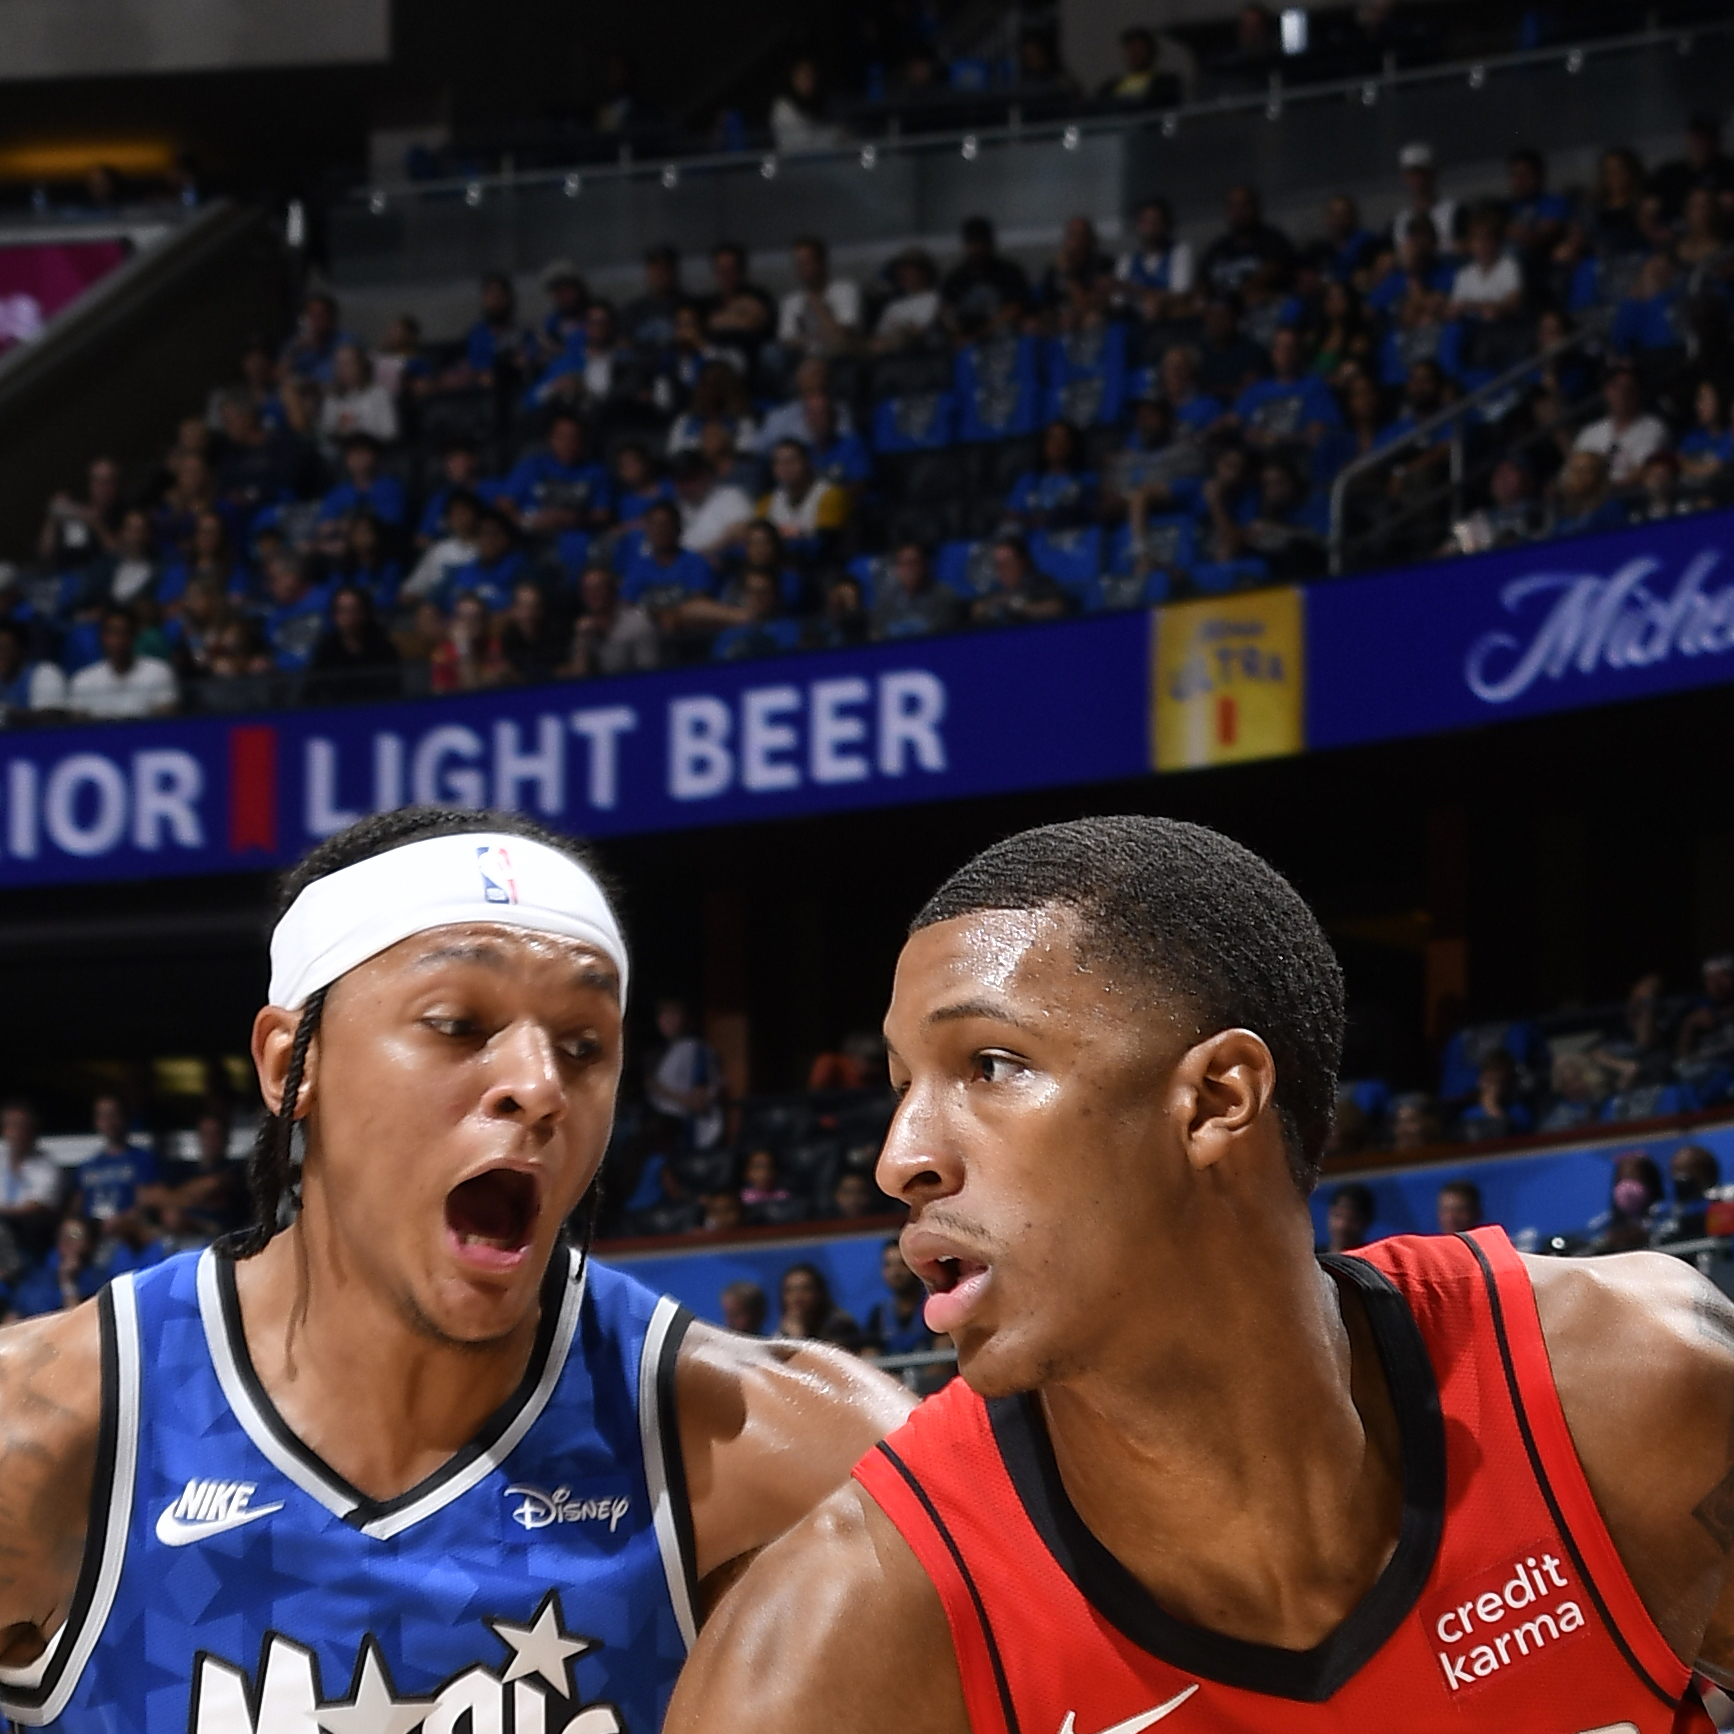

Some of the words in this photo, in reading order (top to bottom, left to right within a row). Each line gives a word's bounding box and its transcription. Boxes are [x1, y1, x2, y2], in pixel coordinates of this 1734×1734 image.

[305, 706, 637, 837] LIGHT
[667, 670, 949, 801] BEER
[8, 748, 205, 860] IOR
[174, 1478, 258, 1522] NIKE
[1436, 1553, 1569, 1644] credit
[1437, 1600, 1586, 1692] karma
